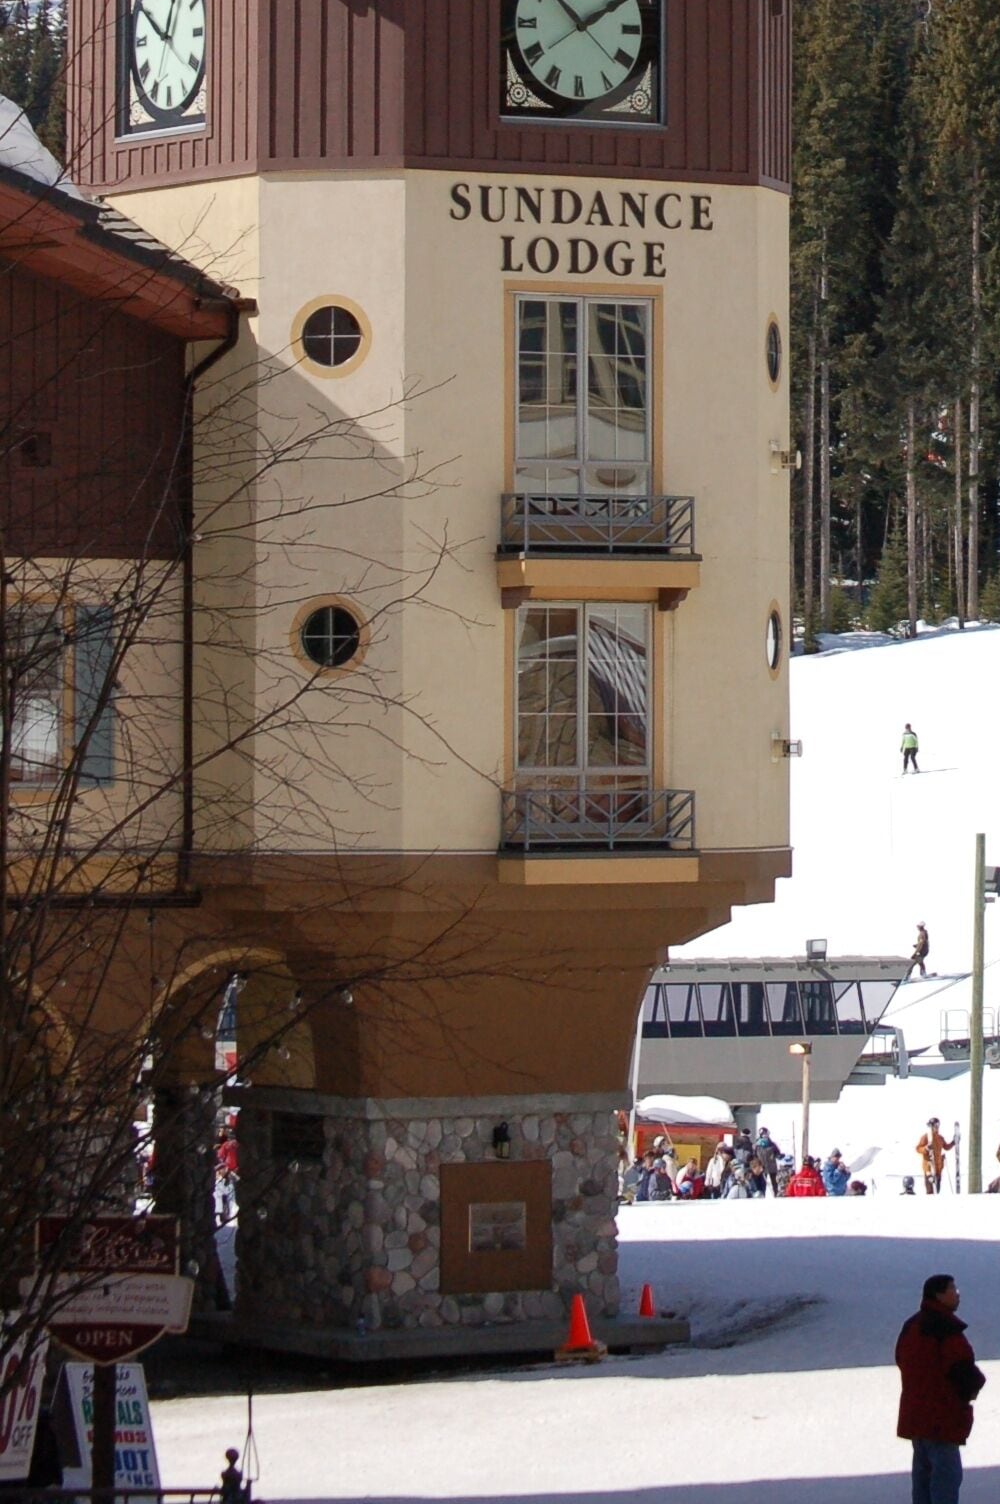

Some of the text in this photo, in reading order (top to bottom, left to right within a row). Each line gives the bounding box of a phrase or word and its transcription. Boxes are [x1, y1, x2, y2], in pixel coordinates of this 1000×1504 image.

[449, 182, 714, 231] SUNDANCE
[500, 236, 667, 278] LODGE
[75, 1329, 133, 1346] OPEN
[82, 1398, 143, 1425] RALS
[12, 1425, 33, 1447] OFF
